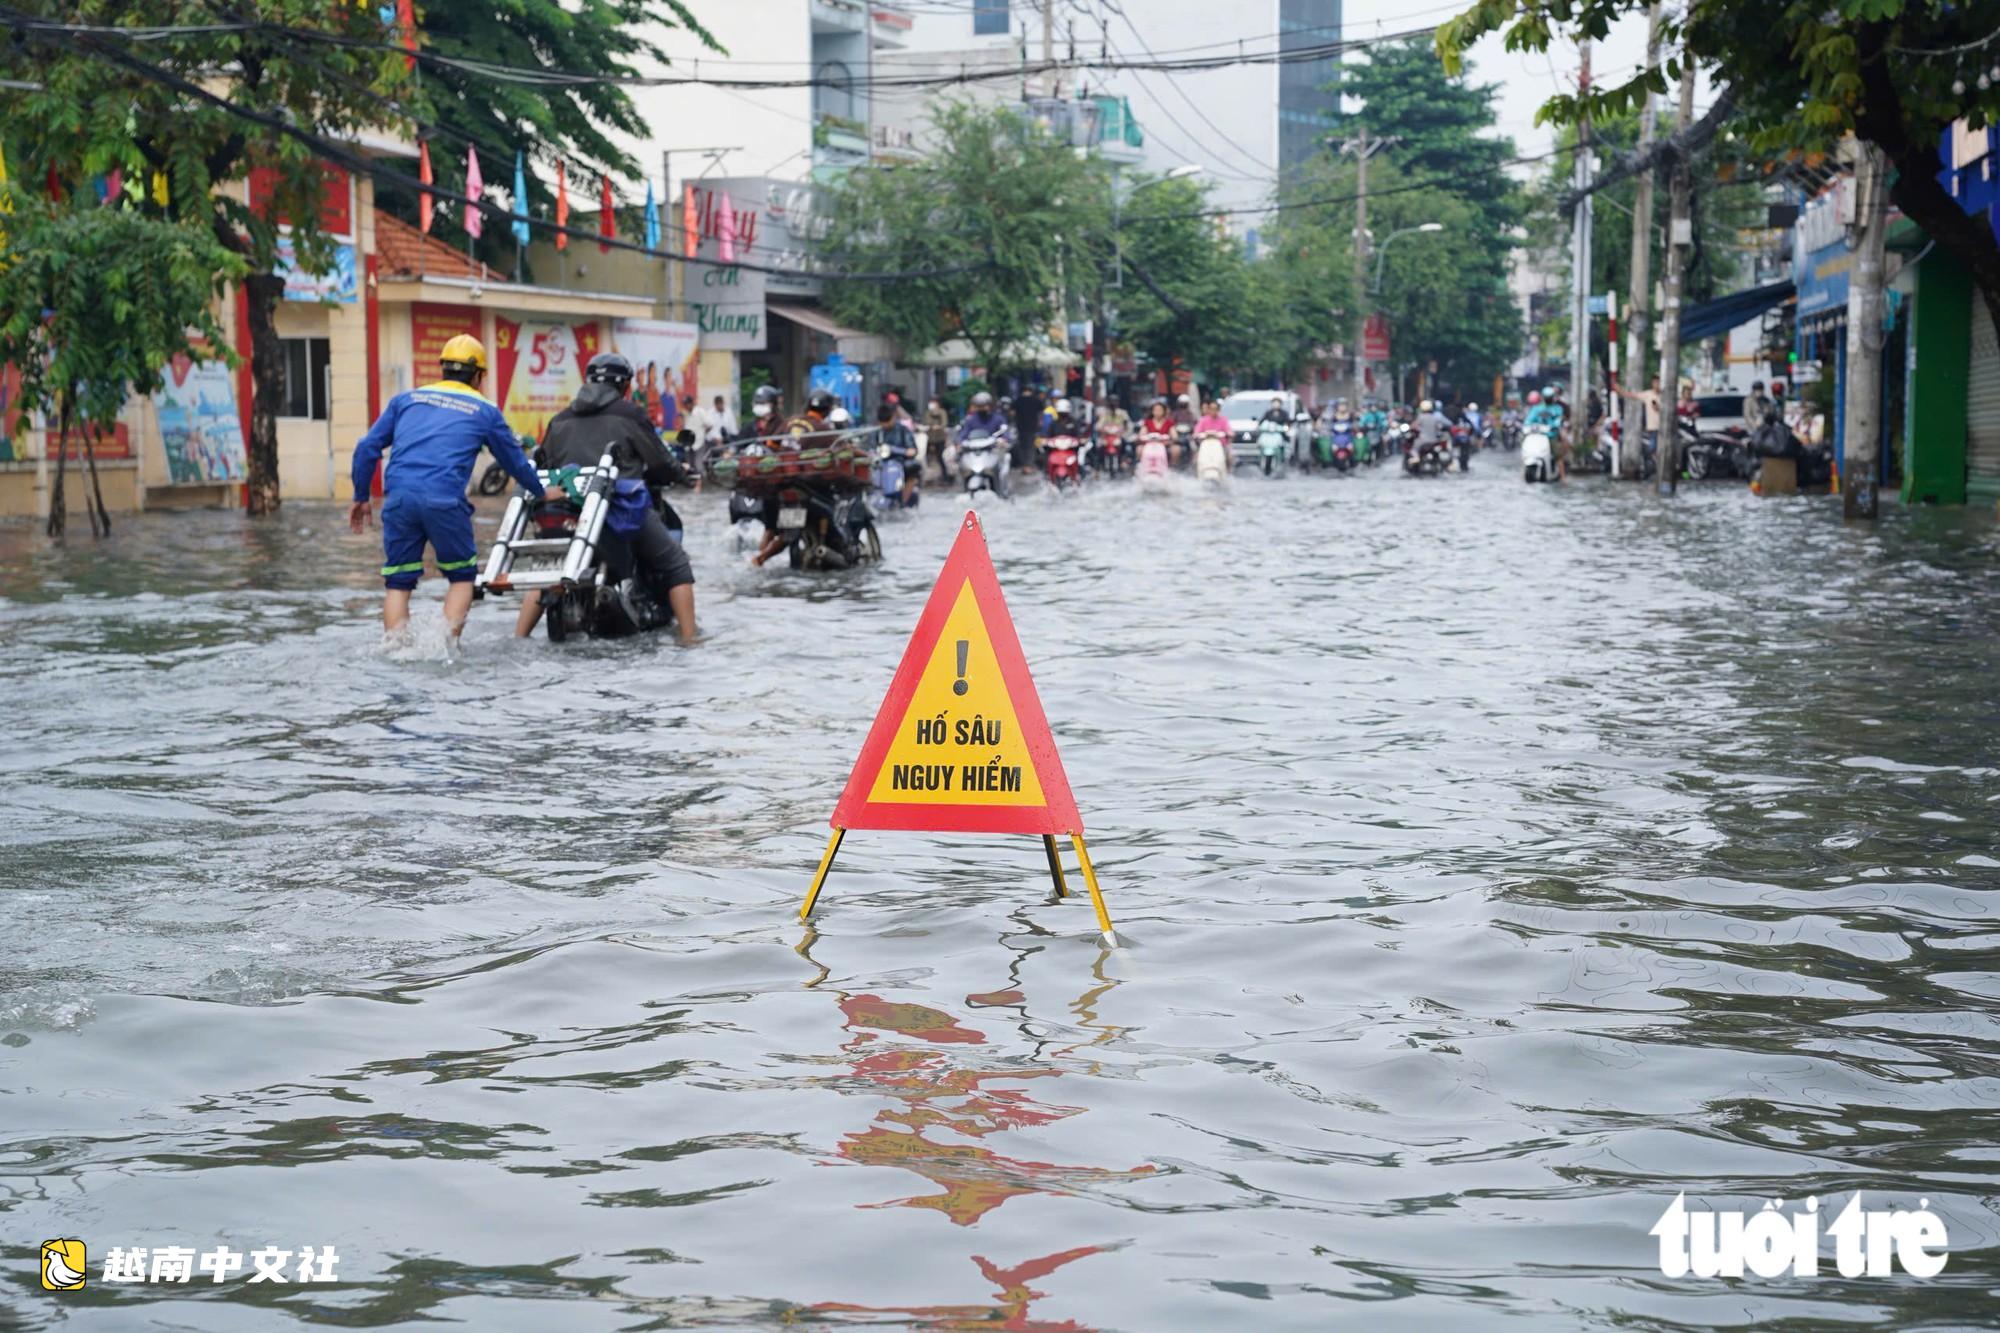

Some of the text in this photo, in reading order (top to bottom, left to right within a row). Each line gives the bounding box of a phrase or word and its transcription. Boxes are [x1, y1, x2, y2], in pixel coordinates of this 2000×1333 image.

[916, 710, 1002, 745] HỐ SÂU
[892, 755, 1022, 792] NGUY HIỂM
